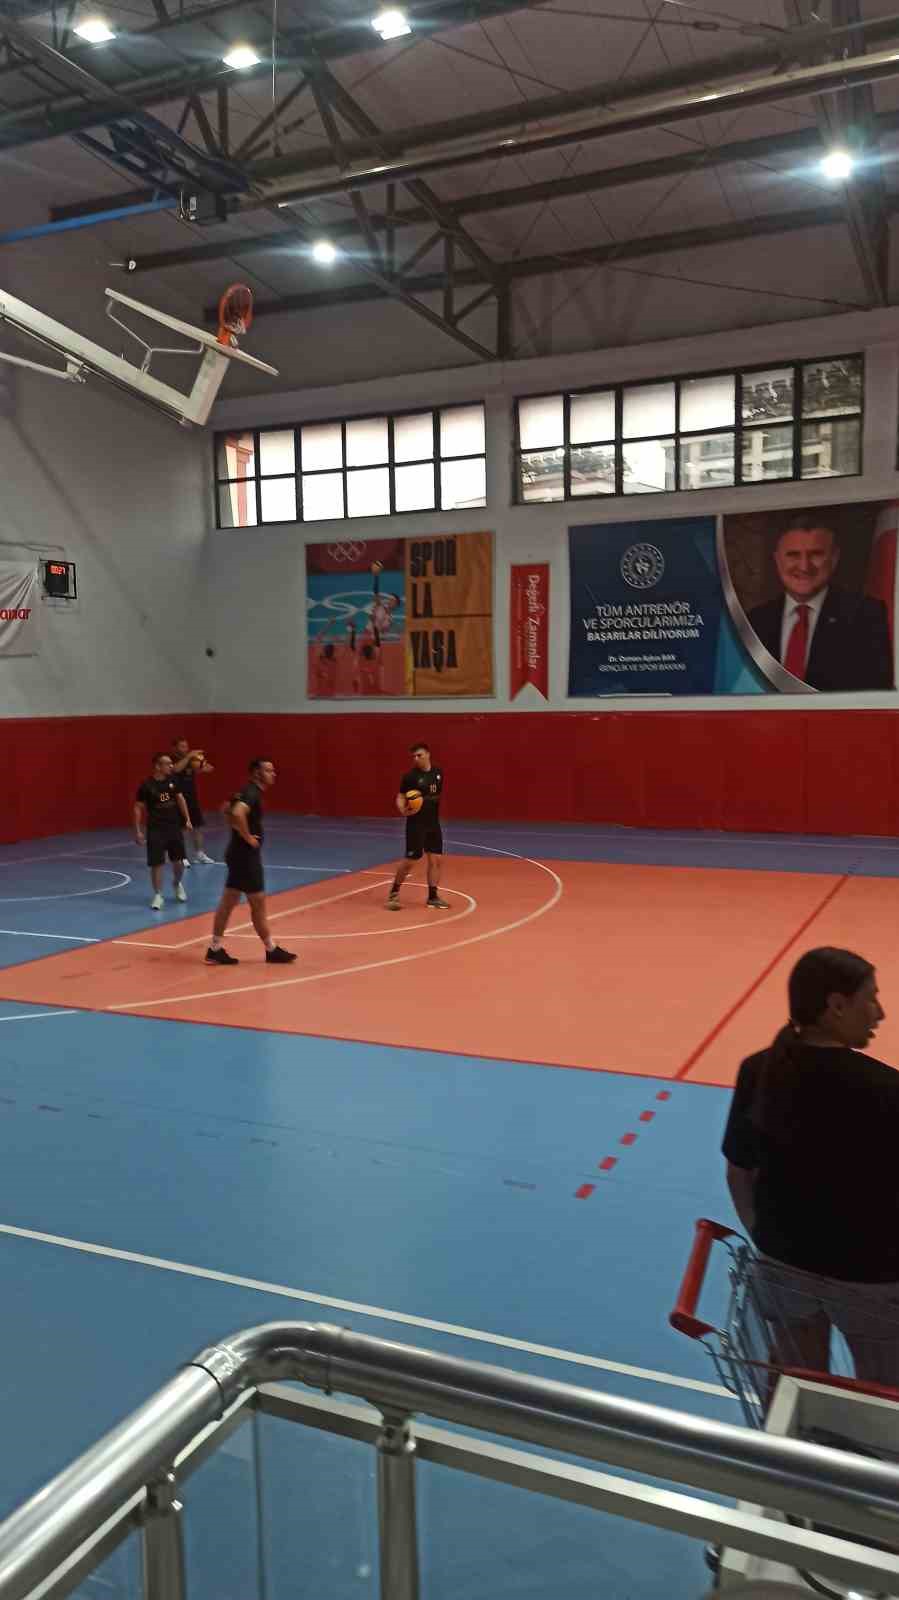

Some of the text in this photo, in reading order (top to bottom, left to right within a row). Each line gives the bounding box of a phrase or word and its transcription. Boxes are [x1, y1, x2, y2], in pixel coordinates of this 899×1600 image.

[410, 540, 457, 576] SPOR
[411, 582, 433, 618] LA
[595, 601, 690, 617] TÜM ANTRENÖR
[527, 574, 541, 669] Değerli Zamanlar
[583, 614, 705, 630] VE SPORCULARIMIZA
[586, 628, 700, 643] BAŞARILAR DİLİYORUM
[410, 630, 458, 672] YAŞA
